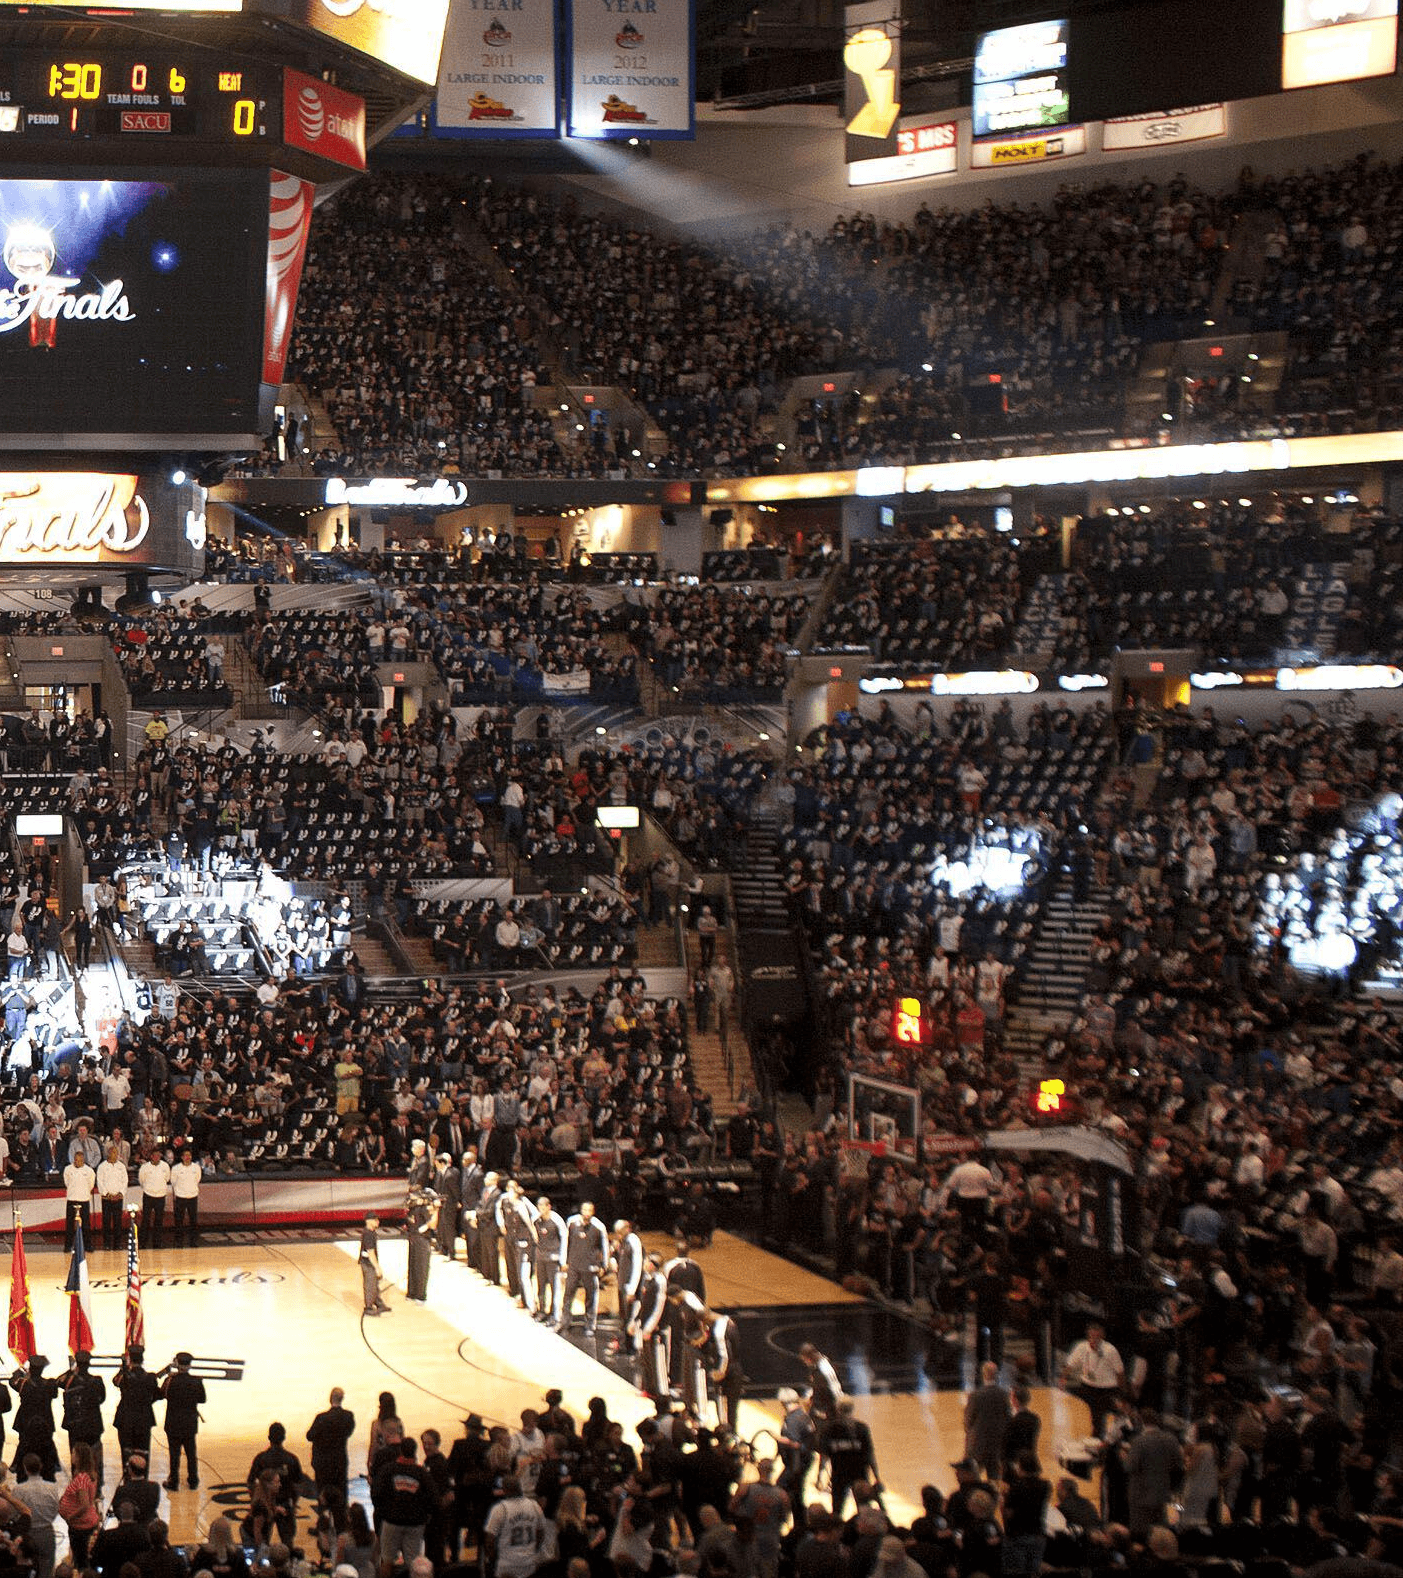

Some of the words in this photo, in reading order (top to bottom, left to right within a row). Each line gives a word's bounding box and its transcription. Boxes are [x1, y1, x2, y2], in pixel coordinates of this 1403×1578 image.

[481, 53, 515, 68] 2011
[613, 55, 648, 70] 2012
[49, 63, 102, 99] 1:30
[131, 63, 147, 91] 0
[169, 67, 186, 93] 6
[218, 71, 242, 92] HEAT
[447, 73, 490, 84] LARGE
[492, 74, 546, 85] INDOOR
[580, 74, 624, 87] LARGE
[626, 76, 680, 88] INDOOR
[107, 93, 131, 105] TEAM
[132, 94, 160, 105] FOULS
[170, 95, 187, 106] TOL
[28, 113, 60, 125] PERIOD
[123, 114, 169, 130] SACU
[233, 100, 255, 135] 0
[12, 276, 137, 326] Finals
[35, 589, 52, 599] 108
[510, 1526, 533, 1546] 21
